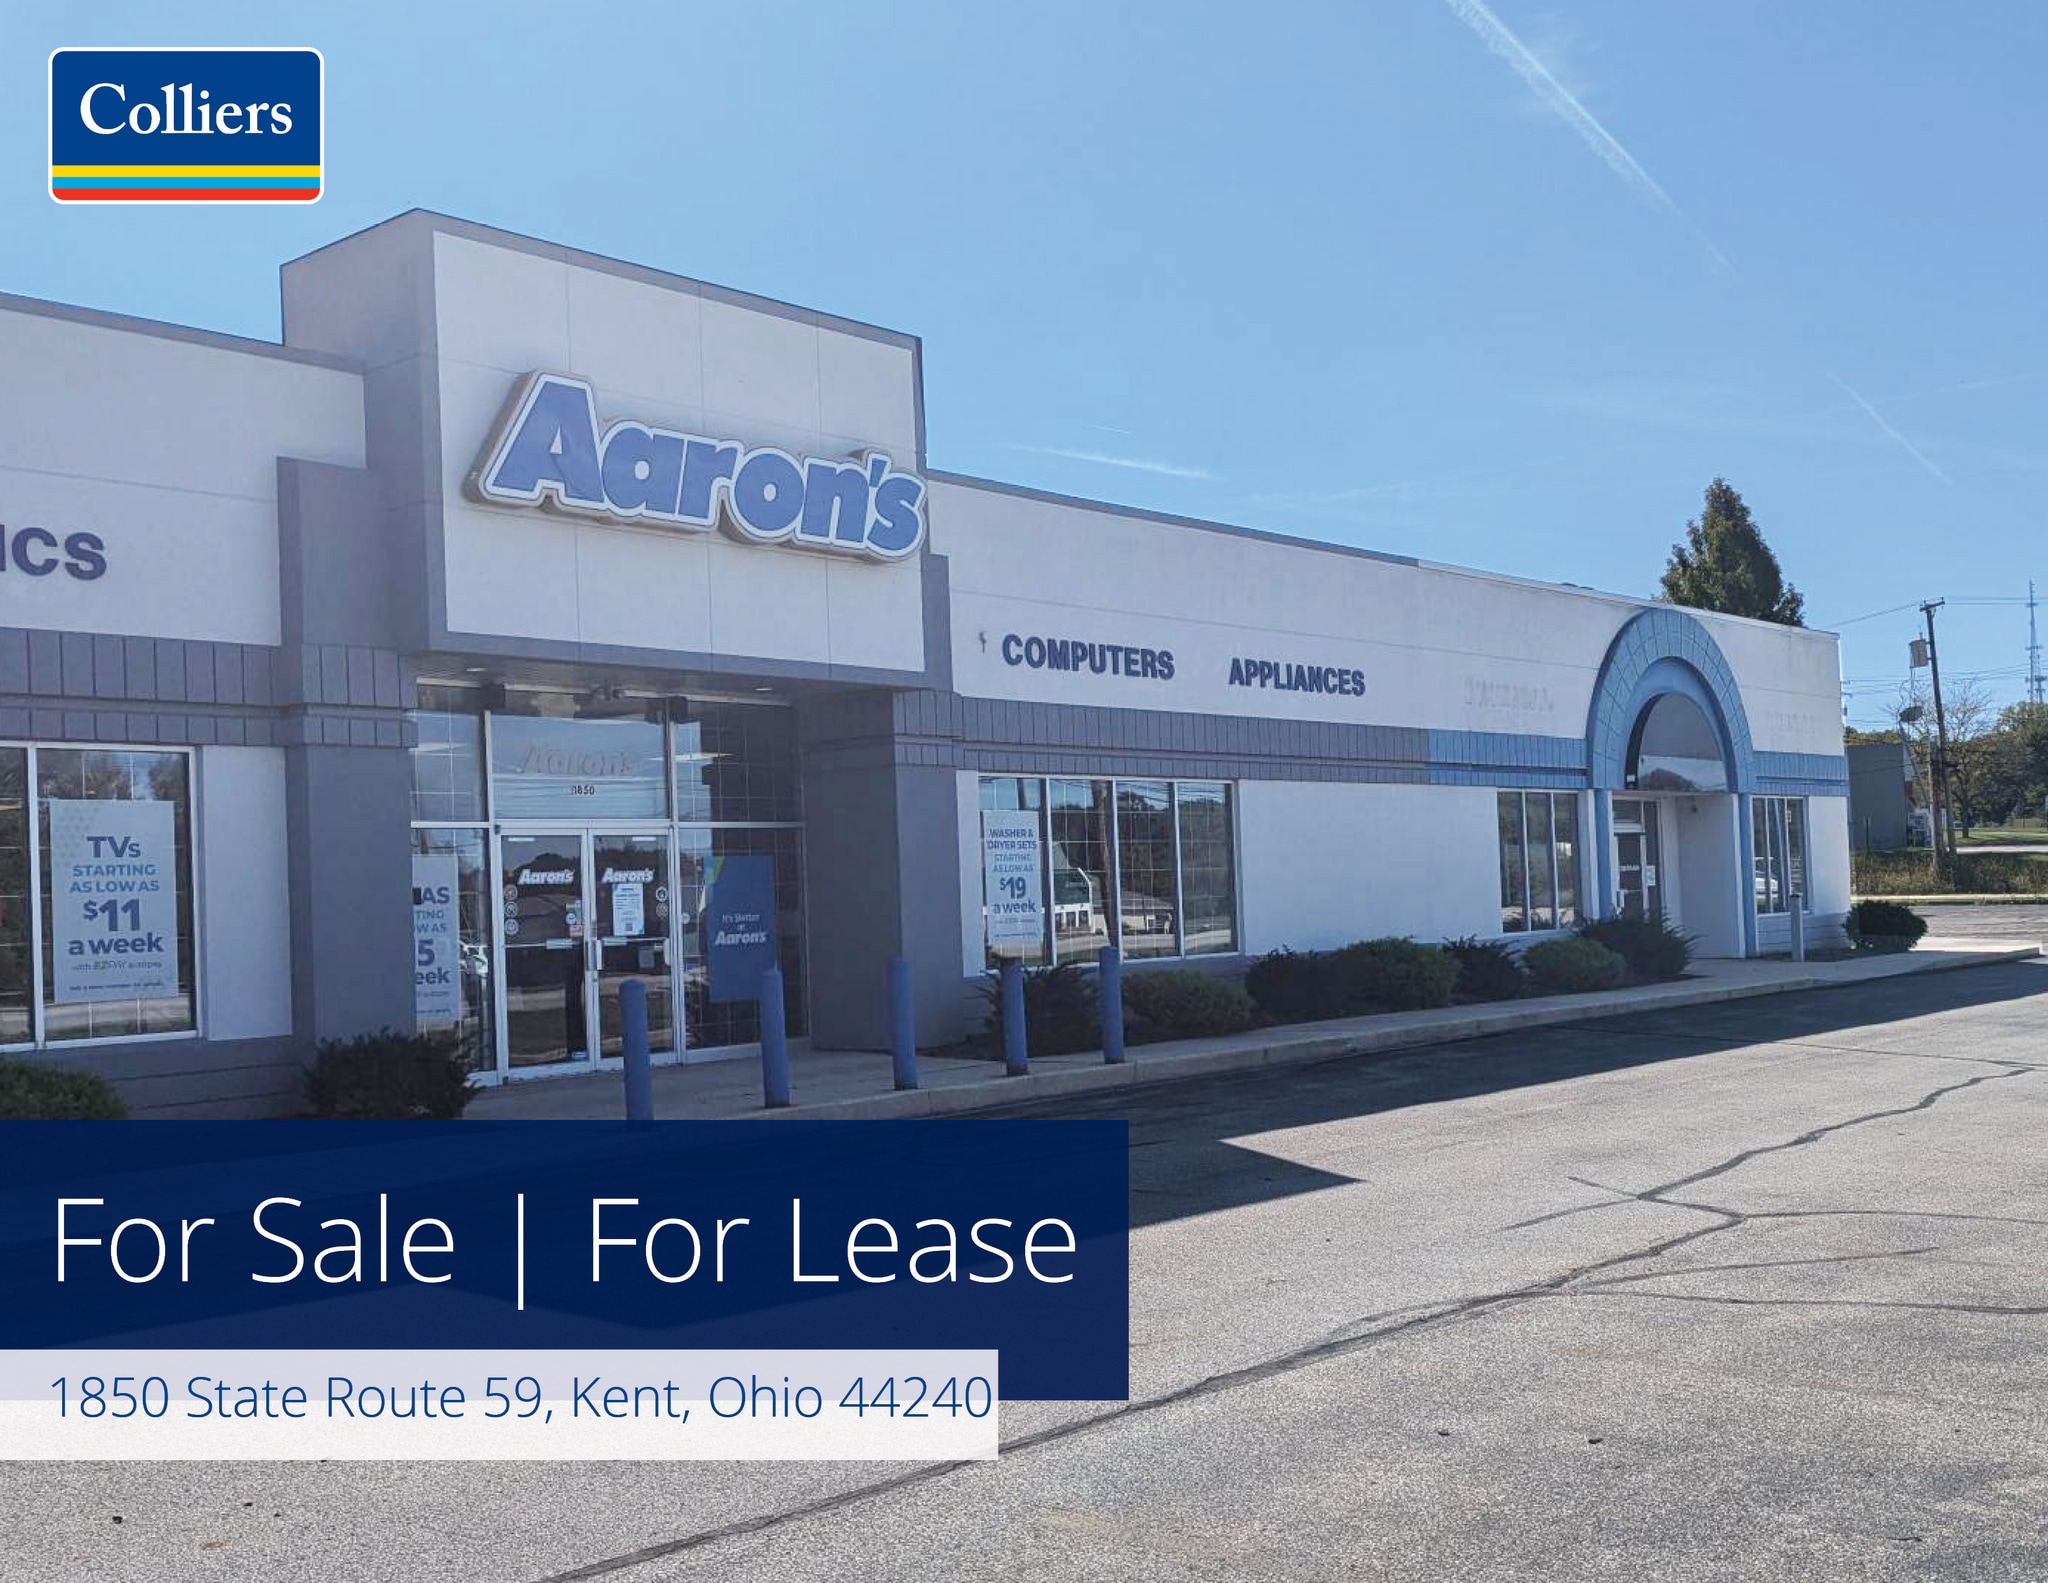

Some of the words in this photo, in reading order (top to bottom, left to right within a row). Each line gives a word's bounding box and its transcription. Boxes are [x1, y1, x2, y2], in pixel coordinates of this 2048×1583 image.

[486, 374, 926, 556] Aaron's
[1002, 633, 1175, 681] COMPUTERS
[1228, 657, 1366, 697] APPLIANCES
[988, 828, 1027, 839] WASHER
[86, 835, 142, 859] TVs
[987, 840, 1016, 850] DRYER
[1017, 840, 1038, 850] SETS
[72, 864, 157, 878] STARTING
[517, 868, 575, 885] Aaron's
[602, 867, 655, 884] Aaron's
[69, 880, 93, 894] AS
[95, 880, 136, 893] LOW
[138, 880, 161, 892] AS
[412, 886, 451, 905] AS
[999, 876, 1027, 900] $19
[82, 898, 141, 932] $11
[1002, 899, 1037, 914] week
[431, 922, 447, 933] AS
[68, 939, 85, 956] a
[88, 932, 165, 955] week
[715, 931, 768, 946] Aaron's
